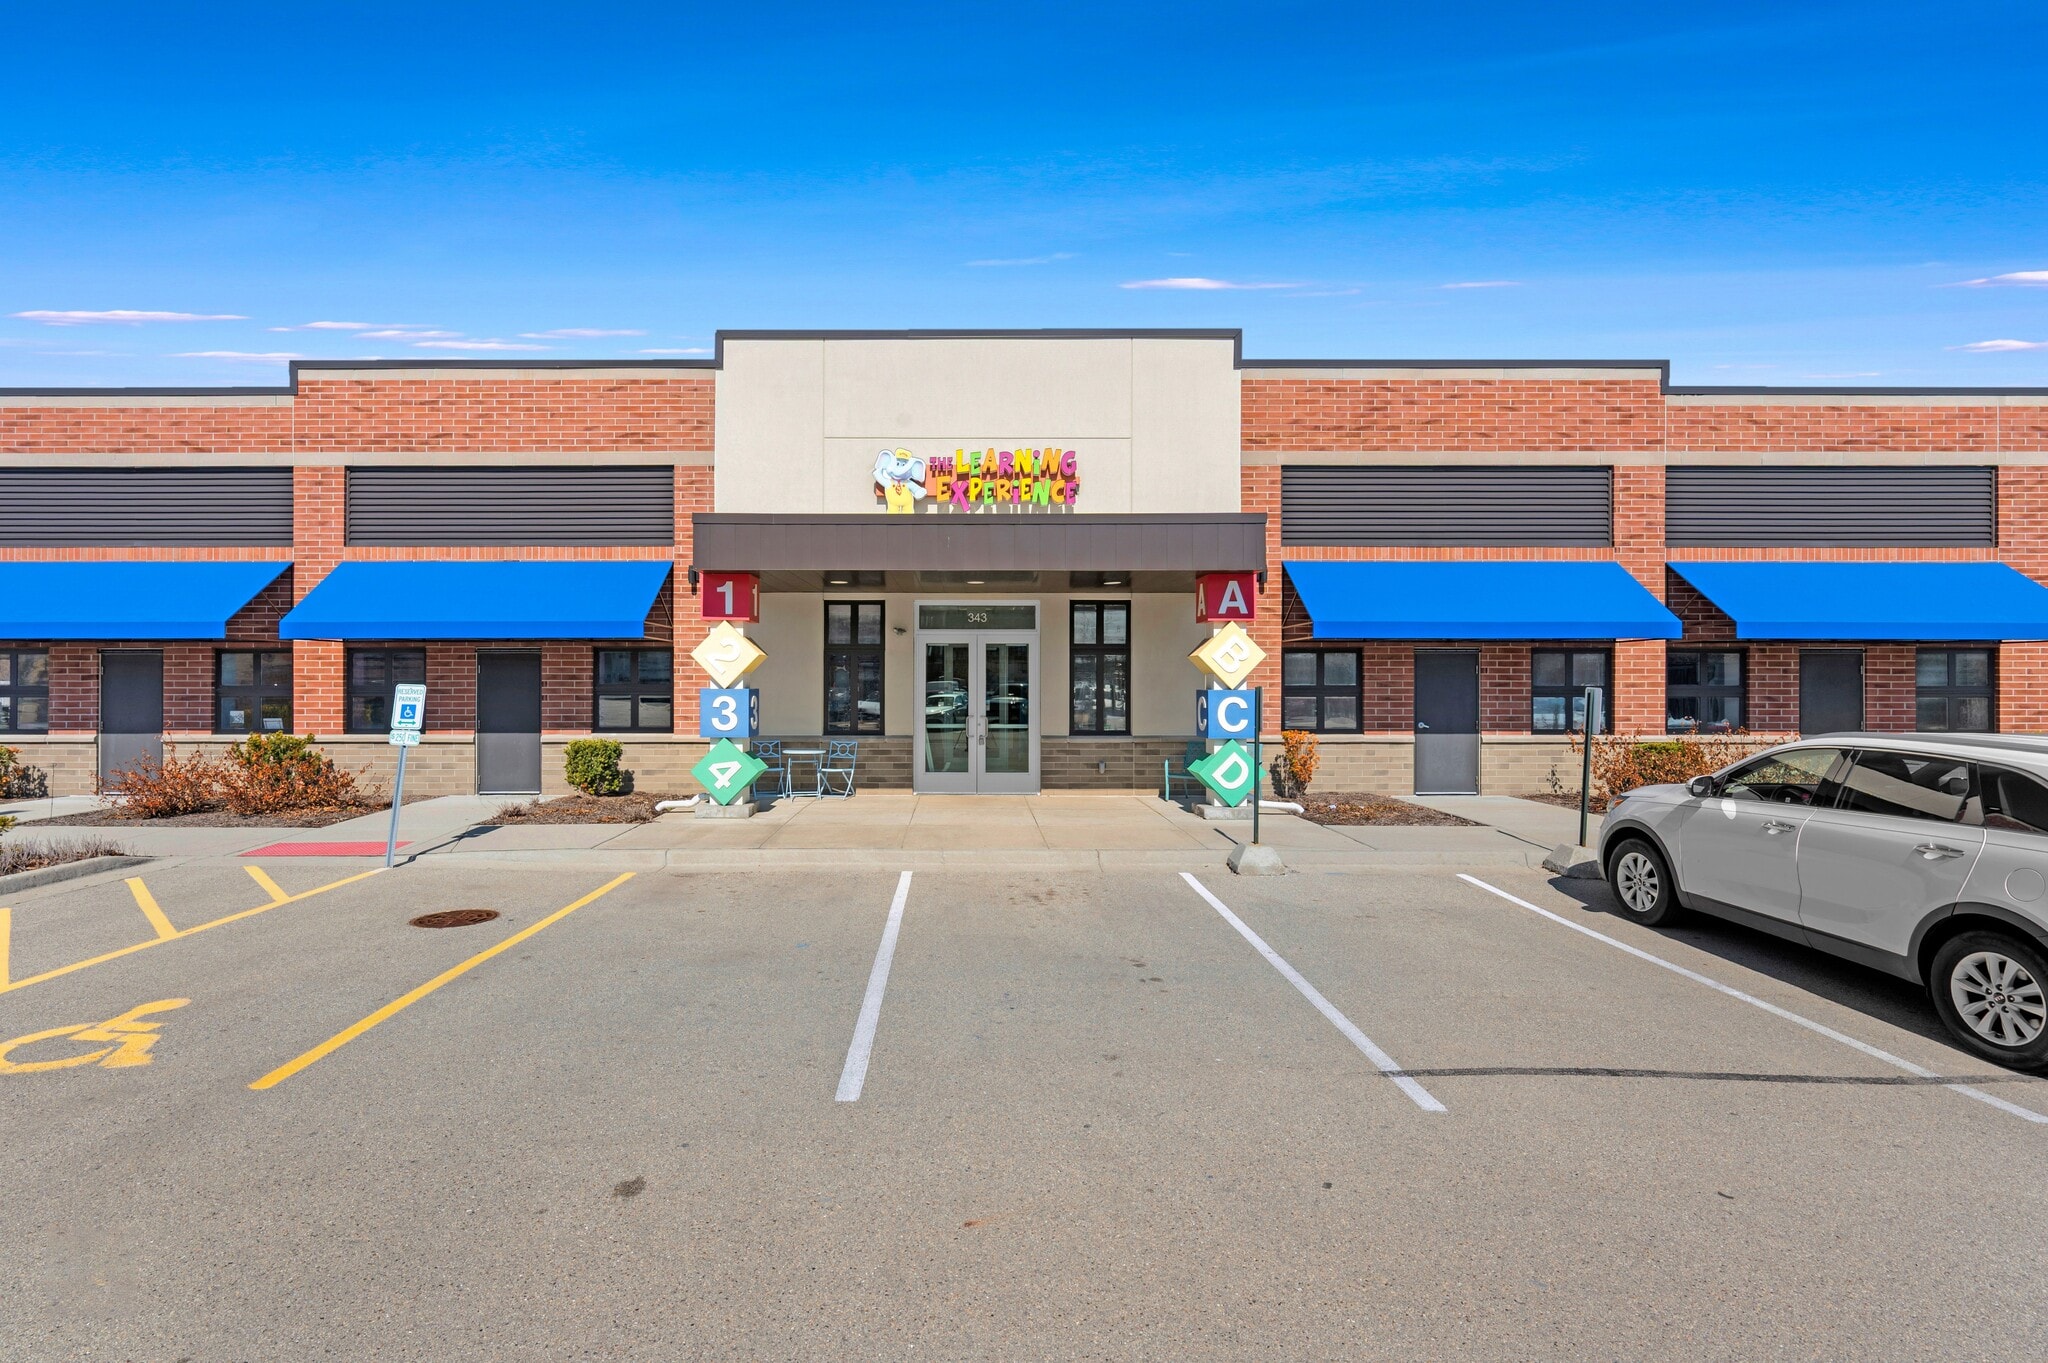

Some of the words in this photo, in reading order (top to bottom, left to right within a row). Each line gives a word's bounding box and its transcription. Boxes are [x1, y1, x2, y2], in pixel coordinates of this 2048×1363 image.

[929, 456, 953, 471] THE
[717, 581, 733, 615] 1
[1197, 583, 1206, 617] A
[1218, 580, 1249, 614] A
[967, 612, 988, 623] 343
[705, 638, 741, 675] 2
[1212, 635, 1250, 673] B
[711, 696, 738, 731] 3
[751, 695, 758, 730] 3
[1198, 696, 1207, 731] C
[1217, 697, 1248, 732] C
[708, 760, 742, 790] 4
[1211, 752, 1249, 790] D
